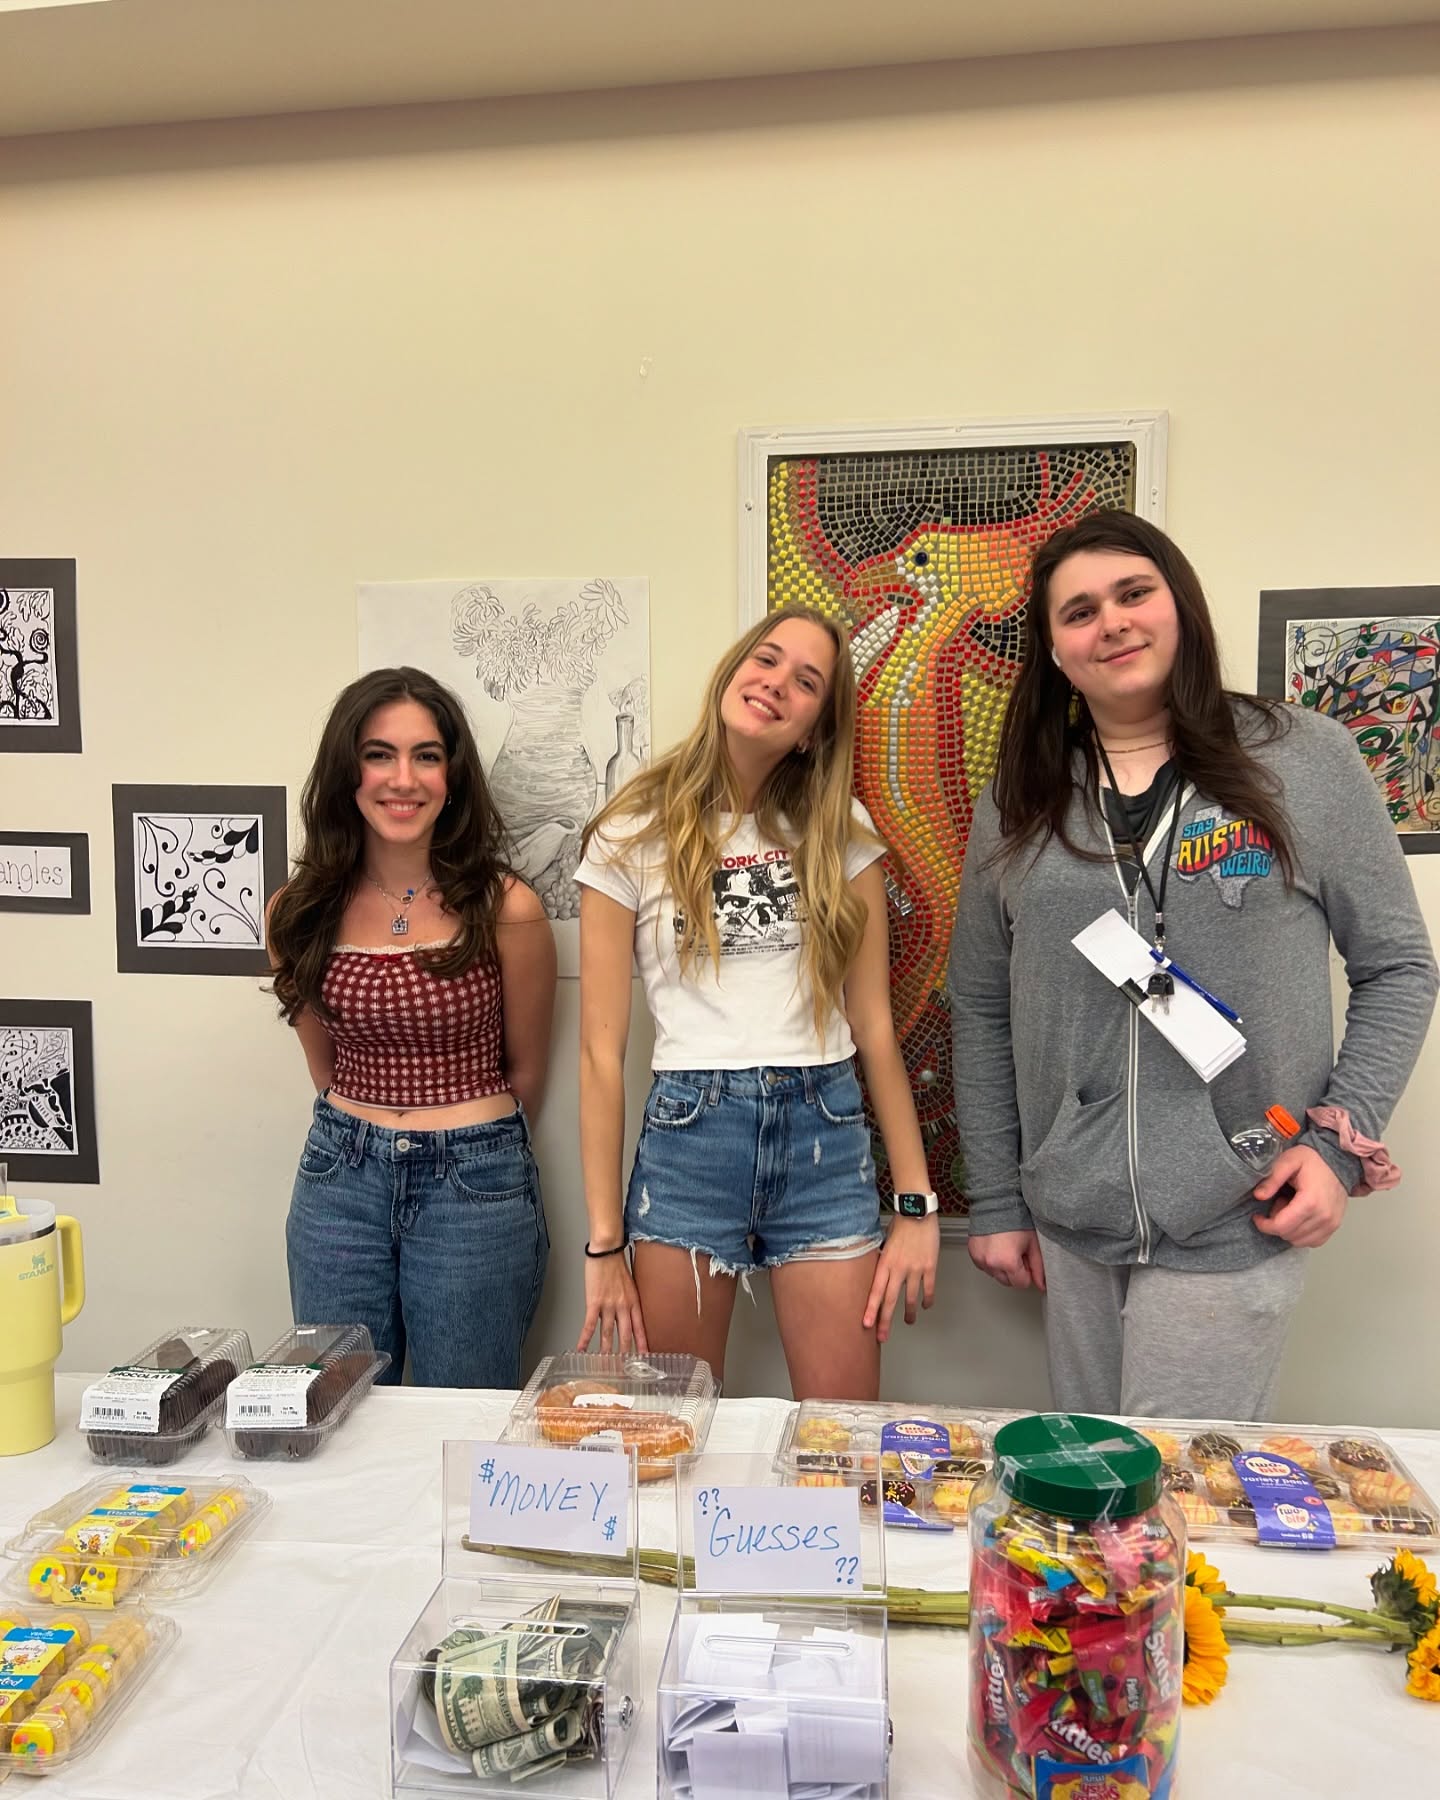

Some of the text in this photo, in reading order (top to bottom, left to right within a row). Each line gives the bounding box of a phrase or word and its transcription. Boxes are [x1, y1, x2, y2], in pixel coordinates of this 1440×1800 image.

[1177, 818, 1271, 873] AUSTIN
[1183, 818, 1215, 838] STAY
[763, 850, 789, 863] CIT
[1220, 851, 1271, 878] WEIRD
[489, 1470, 609, 1521] MONEY
[709, 1507, 840, 1558] Guesses
[1050, 1715, 1112, 1765] kittles
